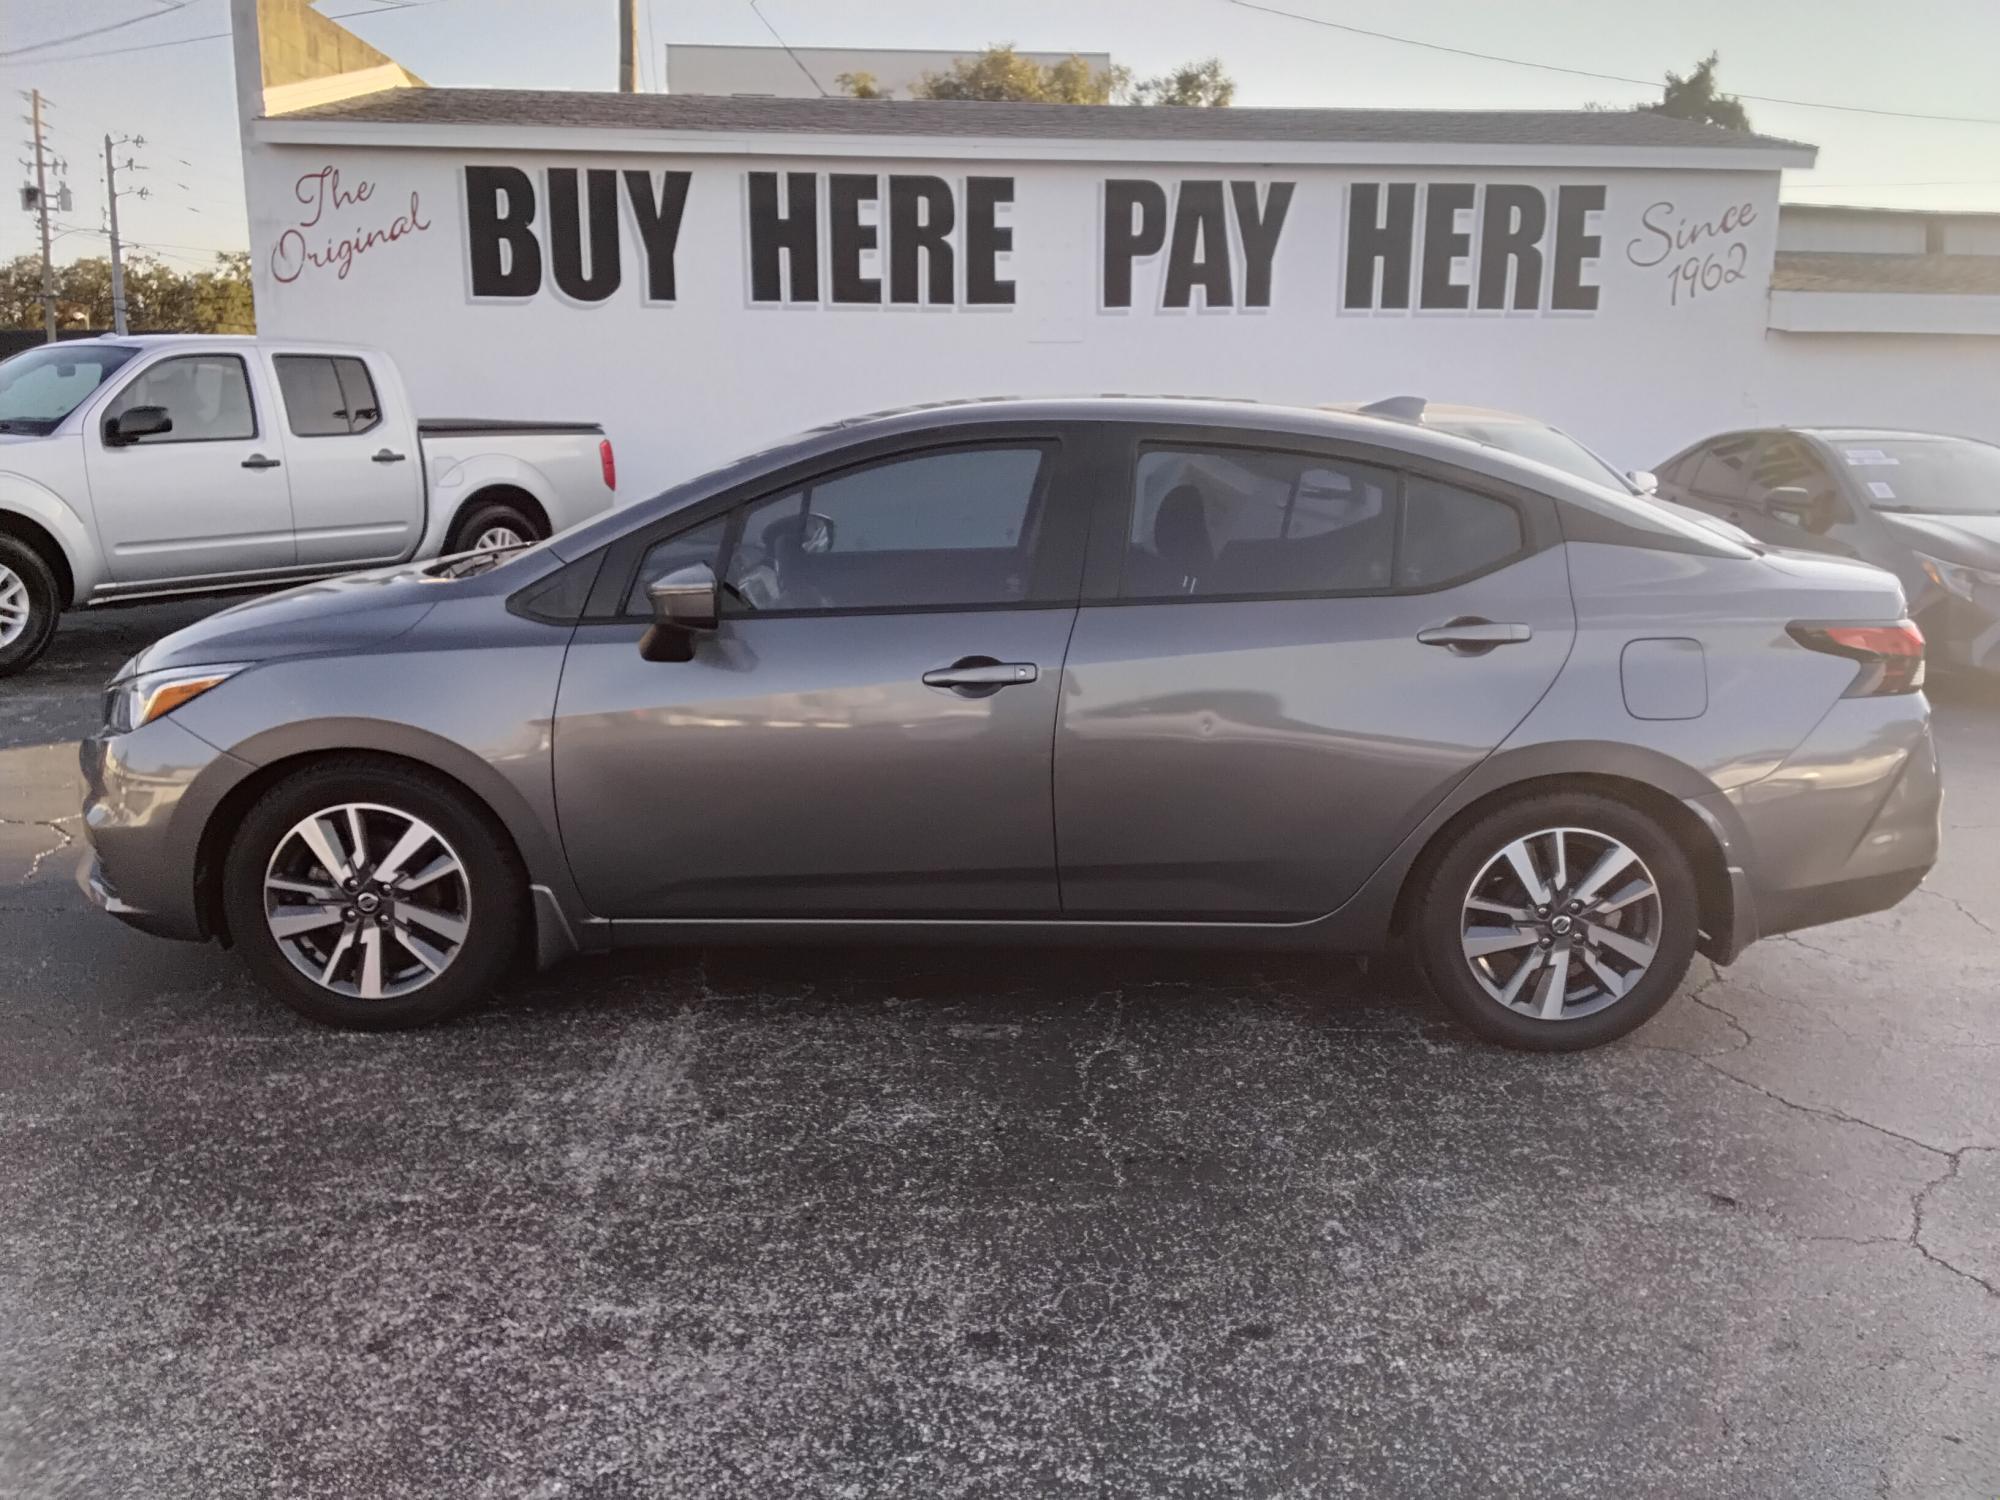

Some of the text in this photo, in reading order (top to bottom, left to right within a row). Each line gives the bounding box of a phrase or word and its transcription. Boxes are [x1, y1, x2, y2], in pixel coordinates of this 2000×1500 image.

[295, 165, 376, 227] The
[270, 191, 432, 284] Original
[464, 165, 1608, 311] BUY HERE PAY HERE
[1626, 201, 1757, 268] Since
[1668, 242, 1748, 306] 1962
